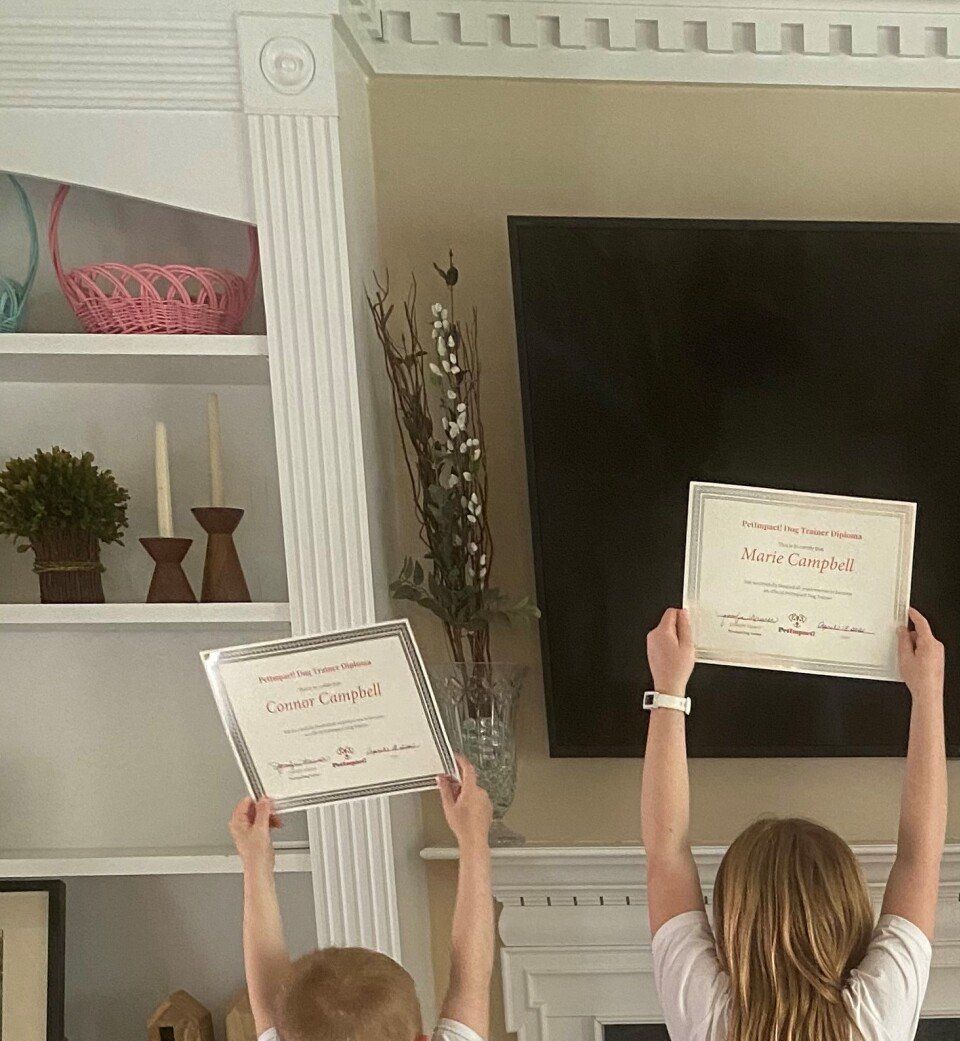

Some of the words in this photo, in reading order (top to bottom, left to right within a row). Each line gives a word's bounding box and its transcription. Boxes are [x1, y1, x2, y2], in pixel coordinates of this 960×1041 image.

[783, 524, 799, 534] Dog
[800, 526, 829, 537] Trainer
[830, 530, 863, 540] Diploma
[741, 546, 784, 565] Marie
[788, 552, 855, 573] Campbell
[266, 697, 315, 714] Connor
[318, 682, 382, 705] Campbell
